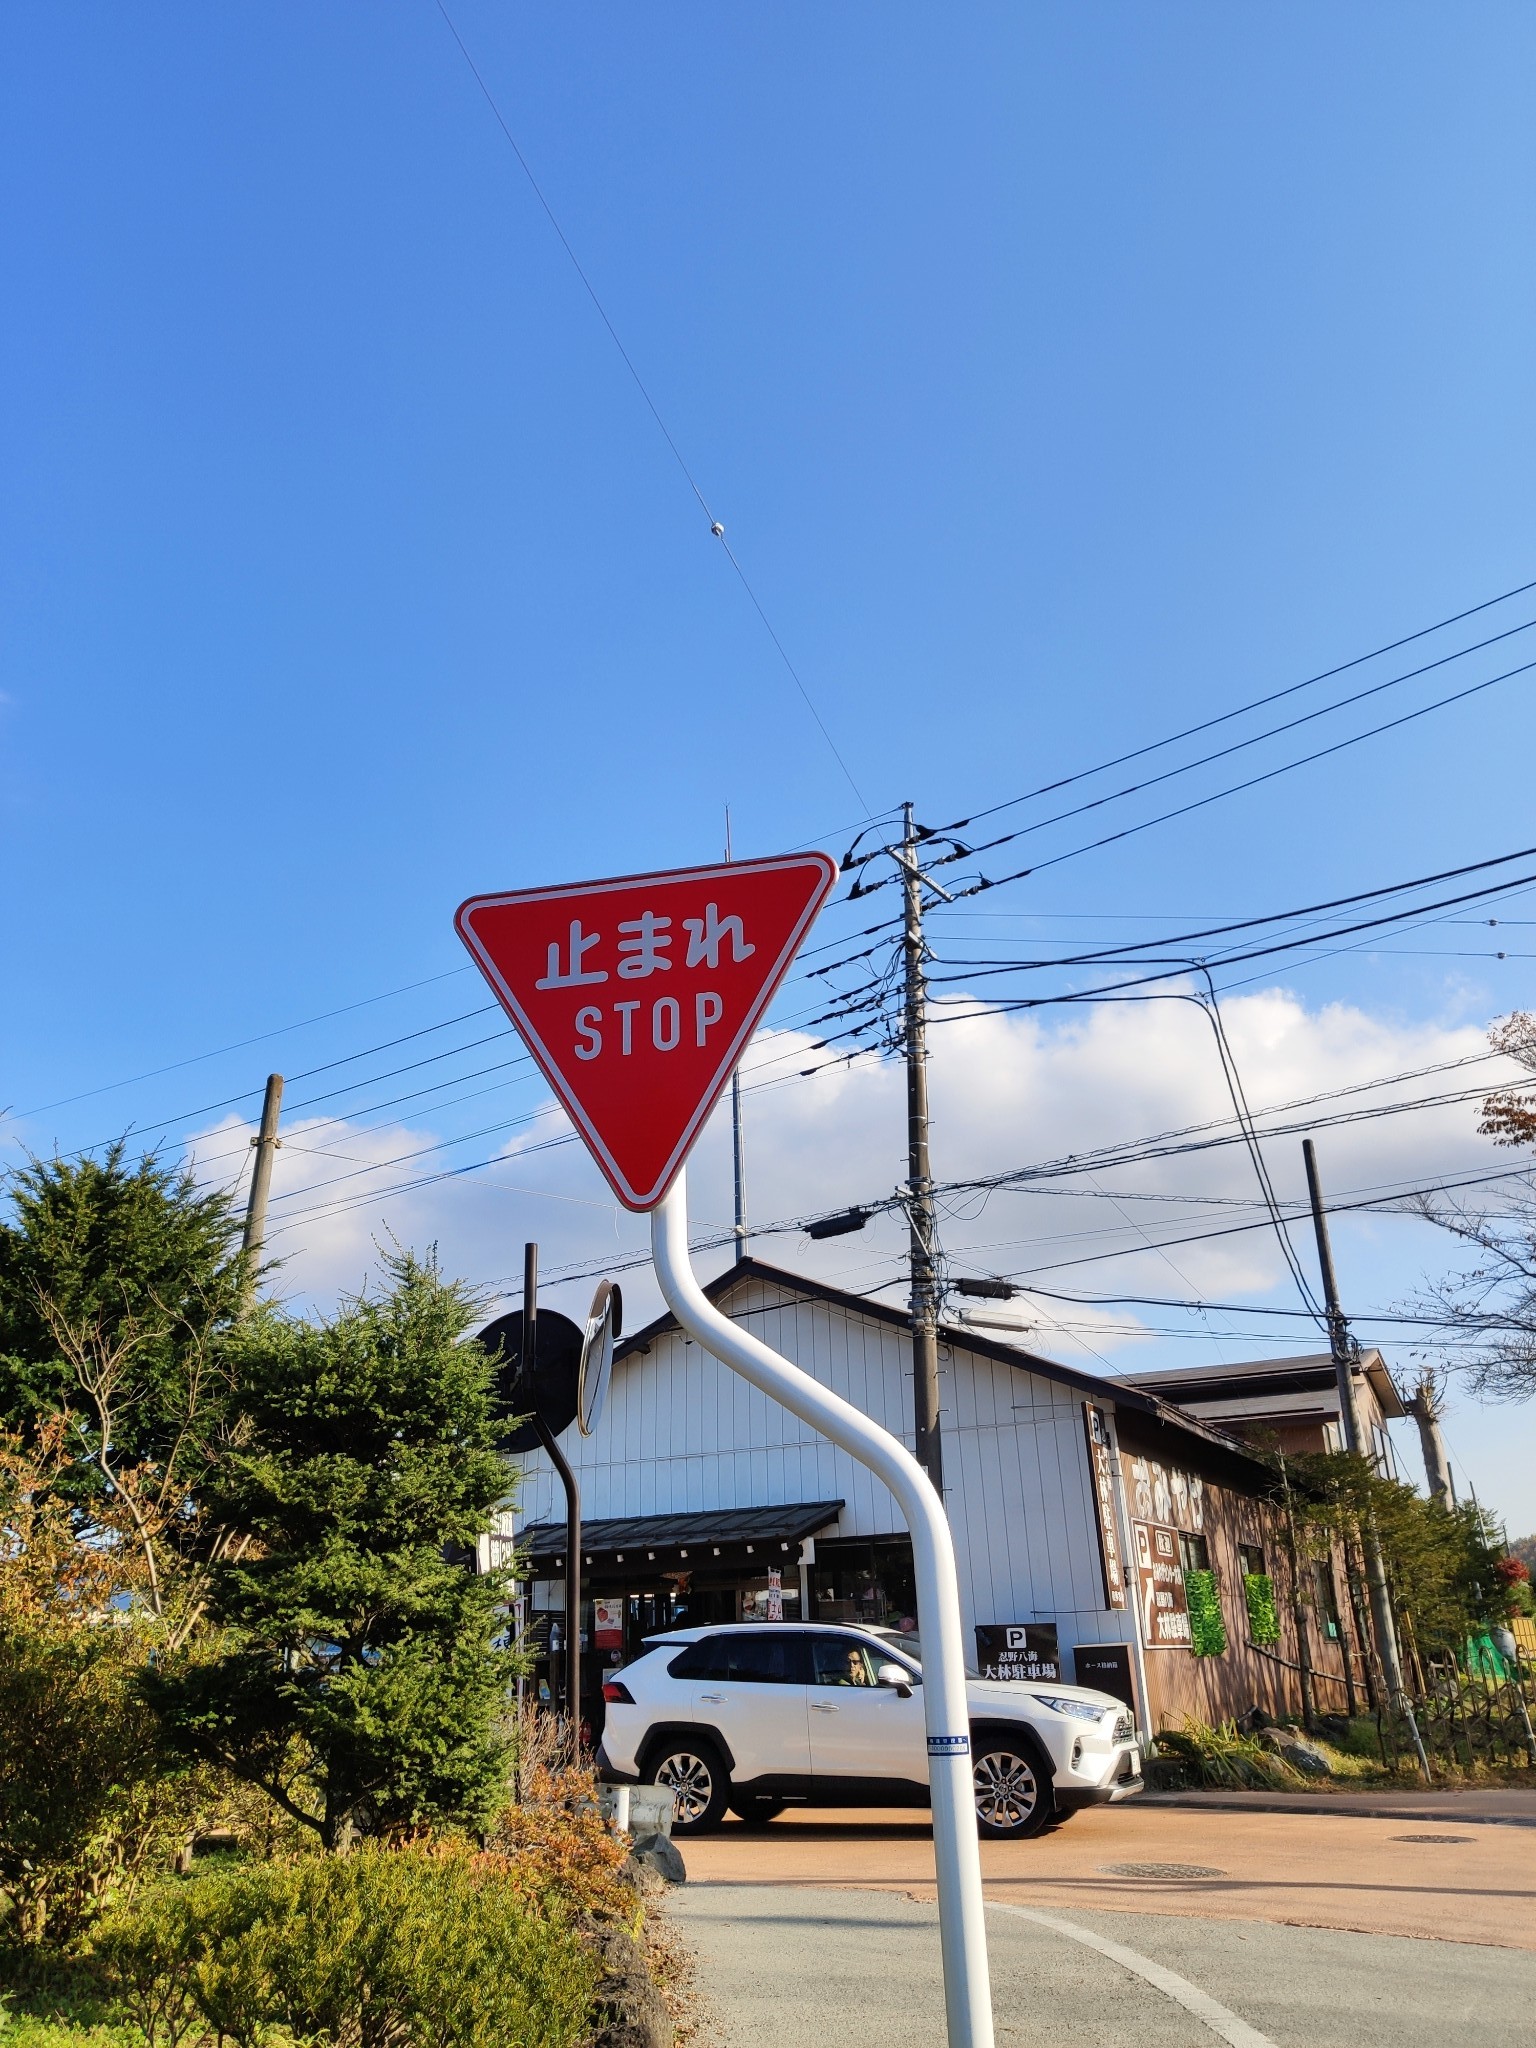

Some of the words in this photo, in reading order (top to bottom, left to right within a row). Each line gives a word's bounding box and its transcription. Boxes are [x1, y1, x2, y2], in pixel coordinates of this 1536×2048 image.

[535, 903, 755, 990] 止まれ
[574, 992, 722, 1061] STOP
[1157, 1612, 1190, 1640] 大林駐車場
[1010, 1631, 1023, 1646] P
[998, 1651, 1038, 1662] 忍野八海
[982, 1663, 1057, 1680] 大林駐車場
